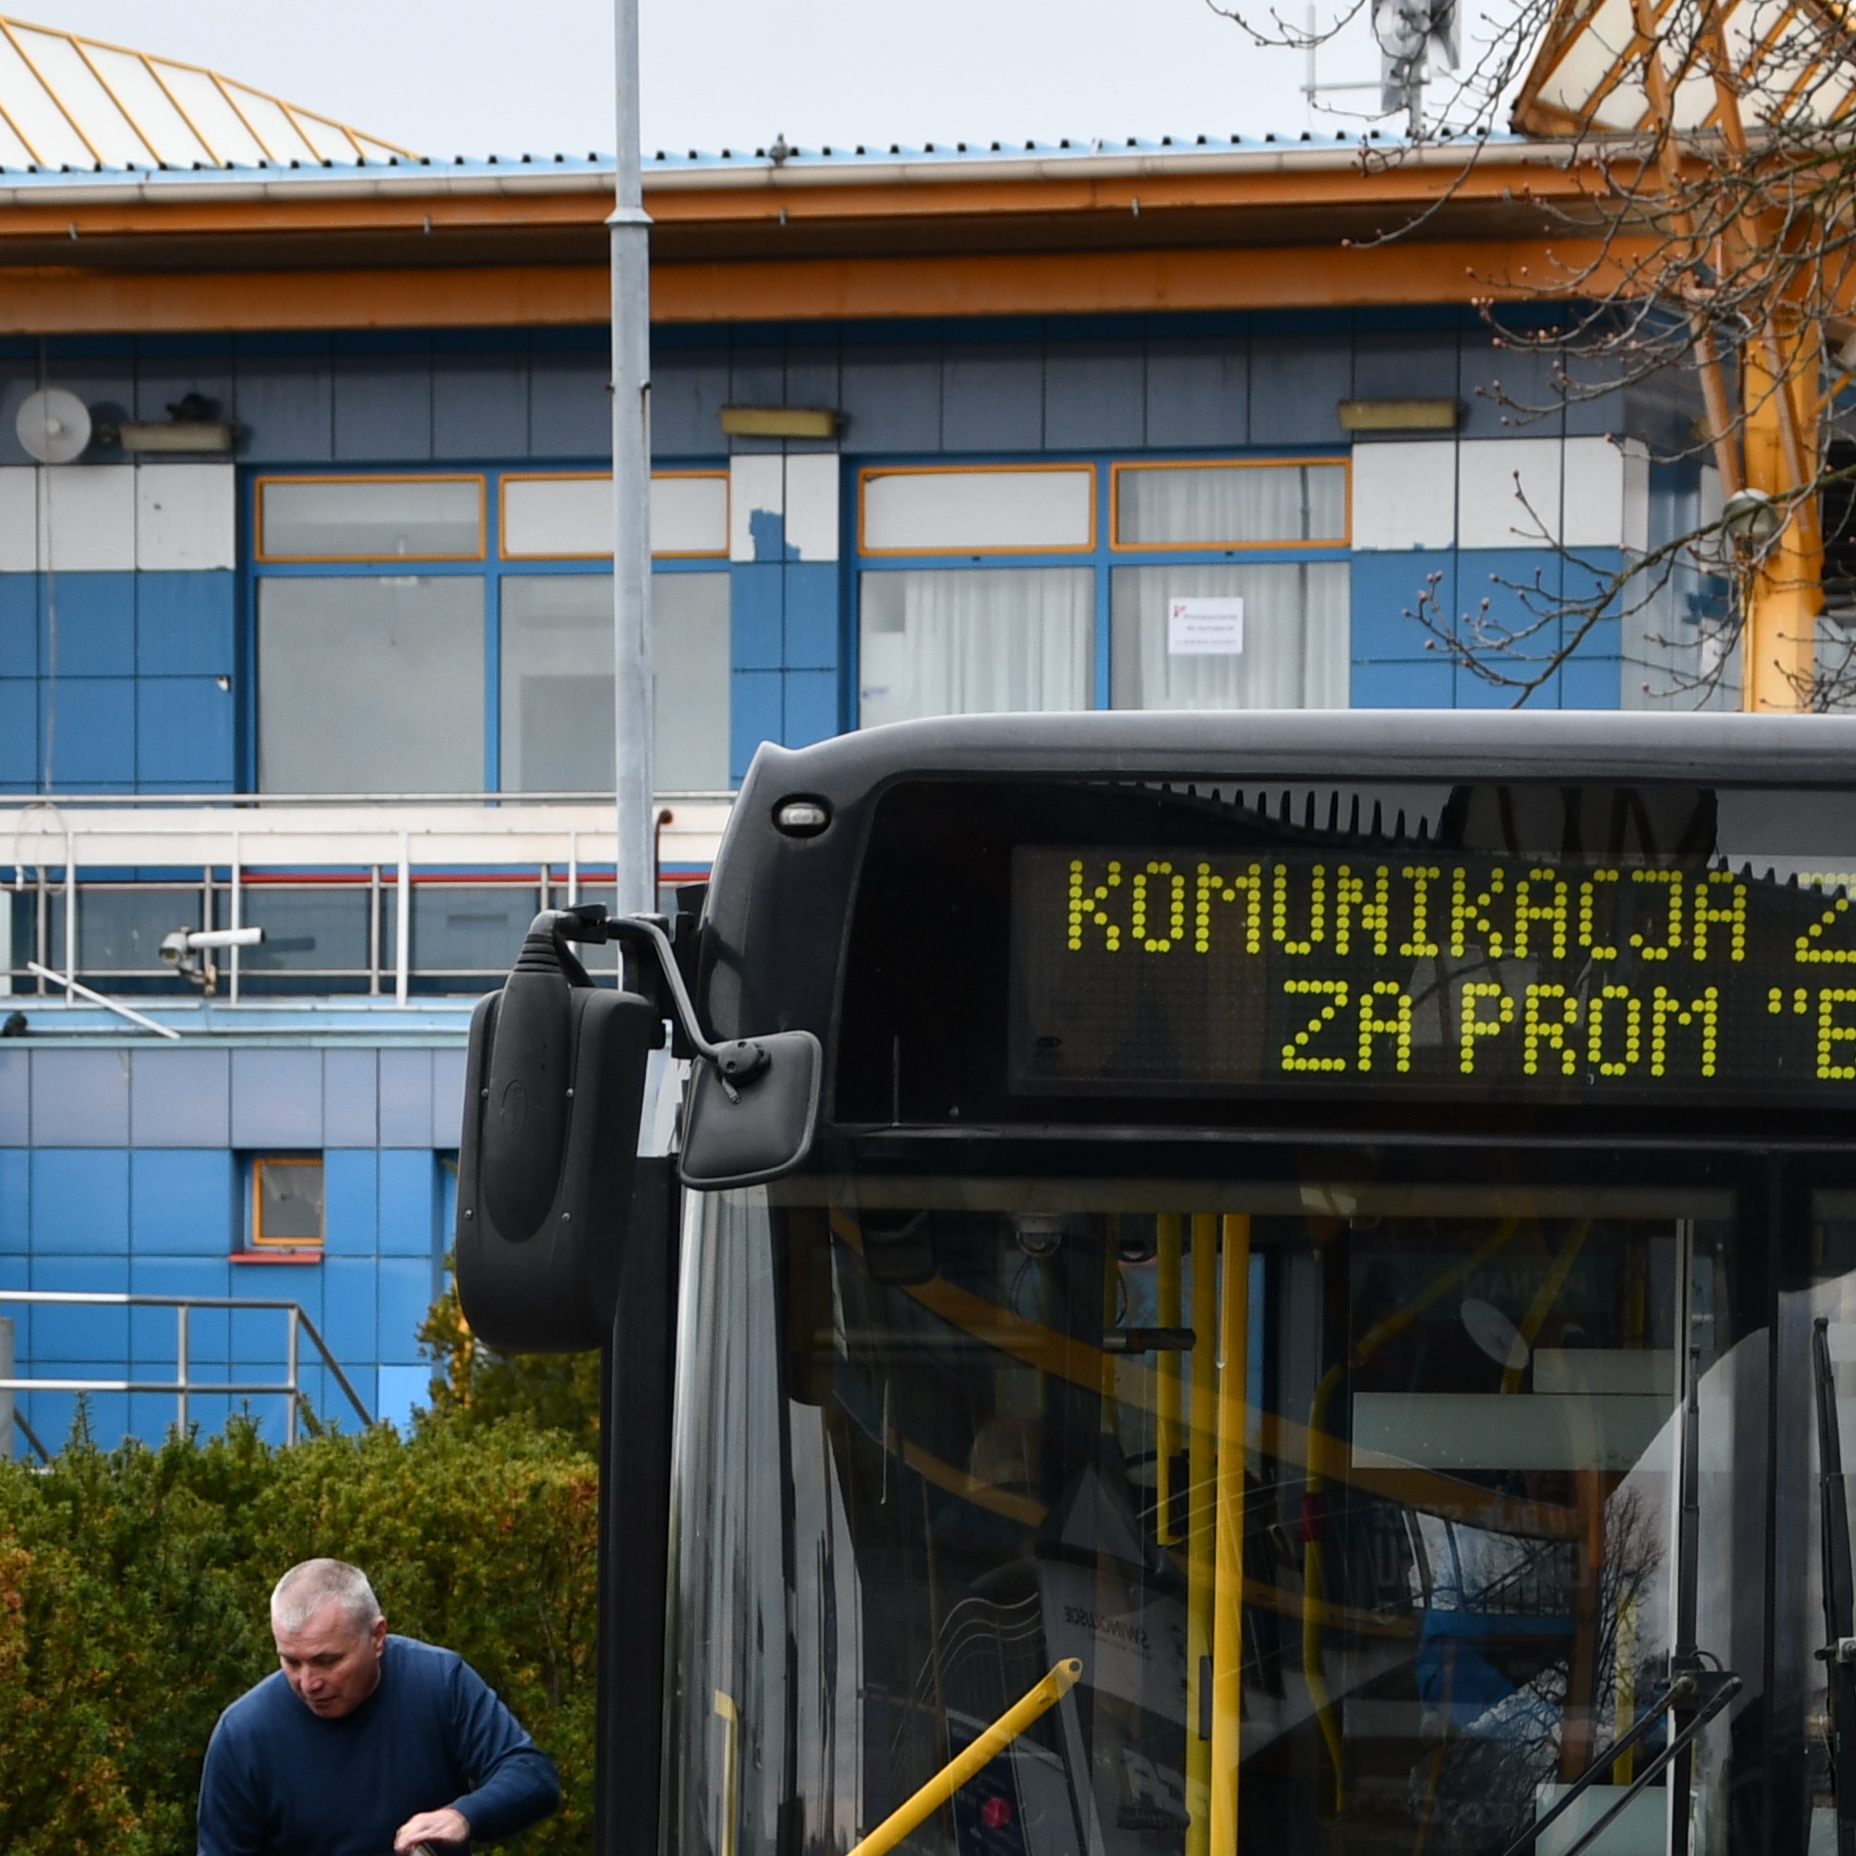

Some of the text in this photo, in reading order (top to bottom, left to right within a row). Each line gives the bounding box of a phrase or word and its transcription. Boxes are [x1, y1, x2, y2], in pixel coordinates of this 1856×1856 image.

[1068, 859, 1746, 962] KOMUNIKACJA
[1281, 980, 1411, 1073] ZA
[1460, 982, 1717, 1078] PROM
